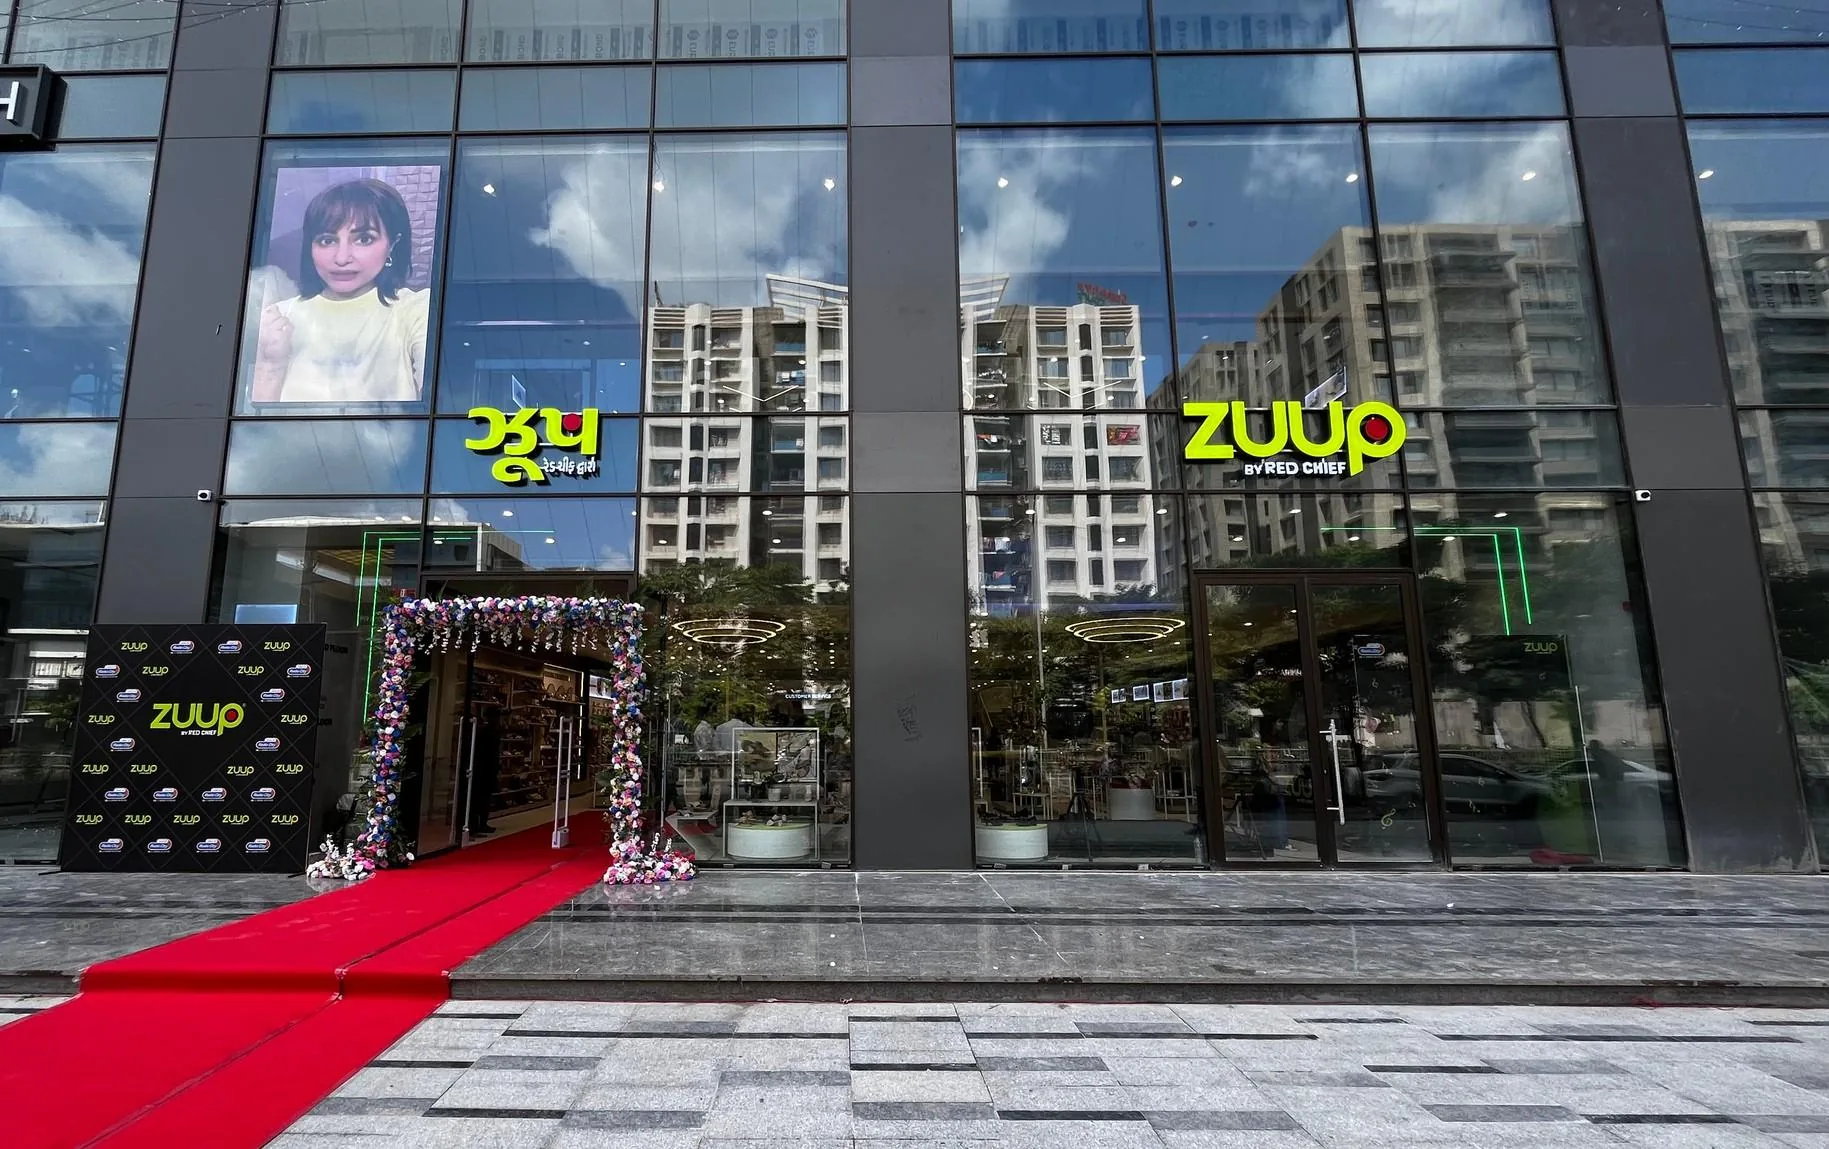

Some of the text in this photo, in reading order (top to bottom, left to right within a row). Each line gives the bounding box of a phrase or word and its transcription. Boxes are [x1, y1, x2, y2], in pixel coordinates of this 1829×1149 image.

[1244, 460, 1347, 475] BY RED CHIEF
